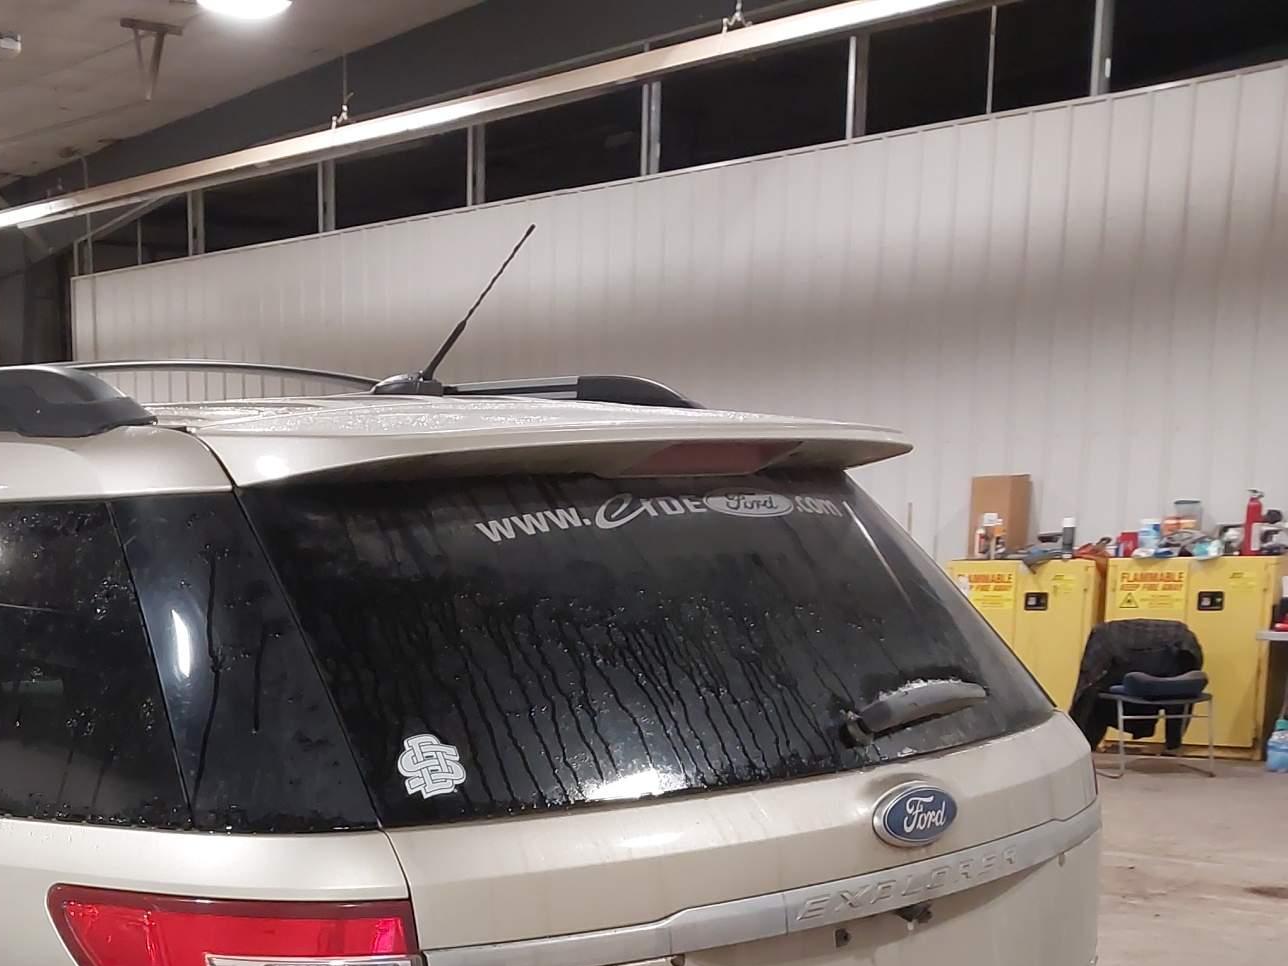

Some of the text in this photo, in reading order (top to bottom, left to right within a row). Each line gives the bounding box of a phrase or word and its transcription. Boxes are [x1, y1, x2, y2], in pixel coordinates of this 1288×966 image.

[1120, 571, 1184, 582] FLAMMABLE
[904, 795, 947, 833] Ford
[796, 844, 1018, 922] EXPLORER
